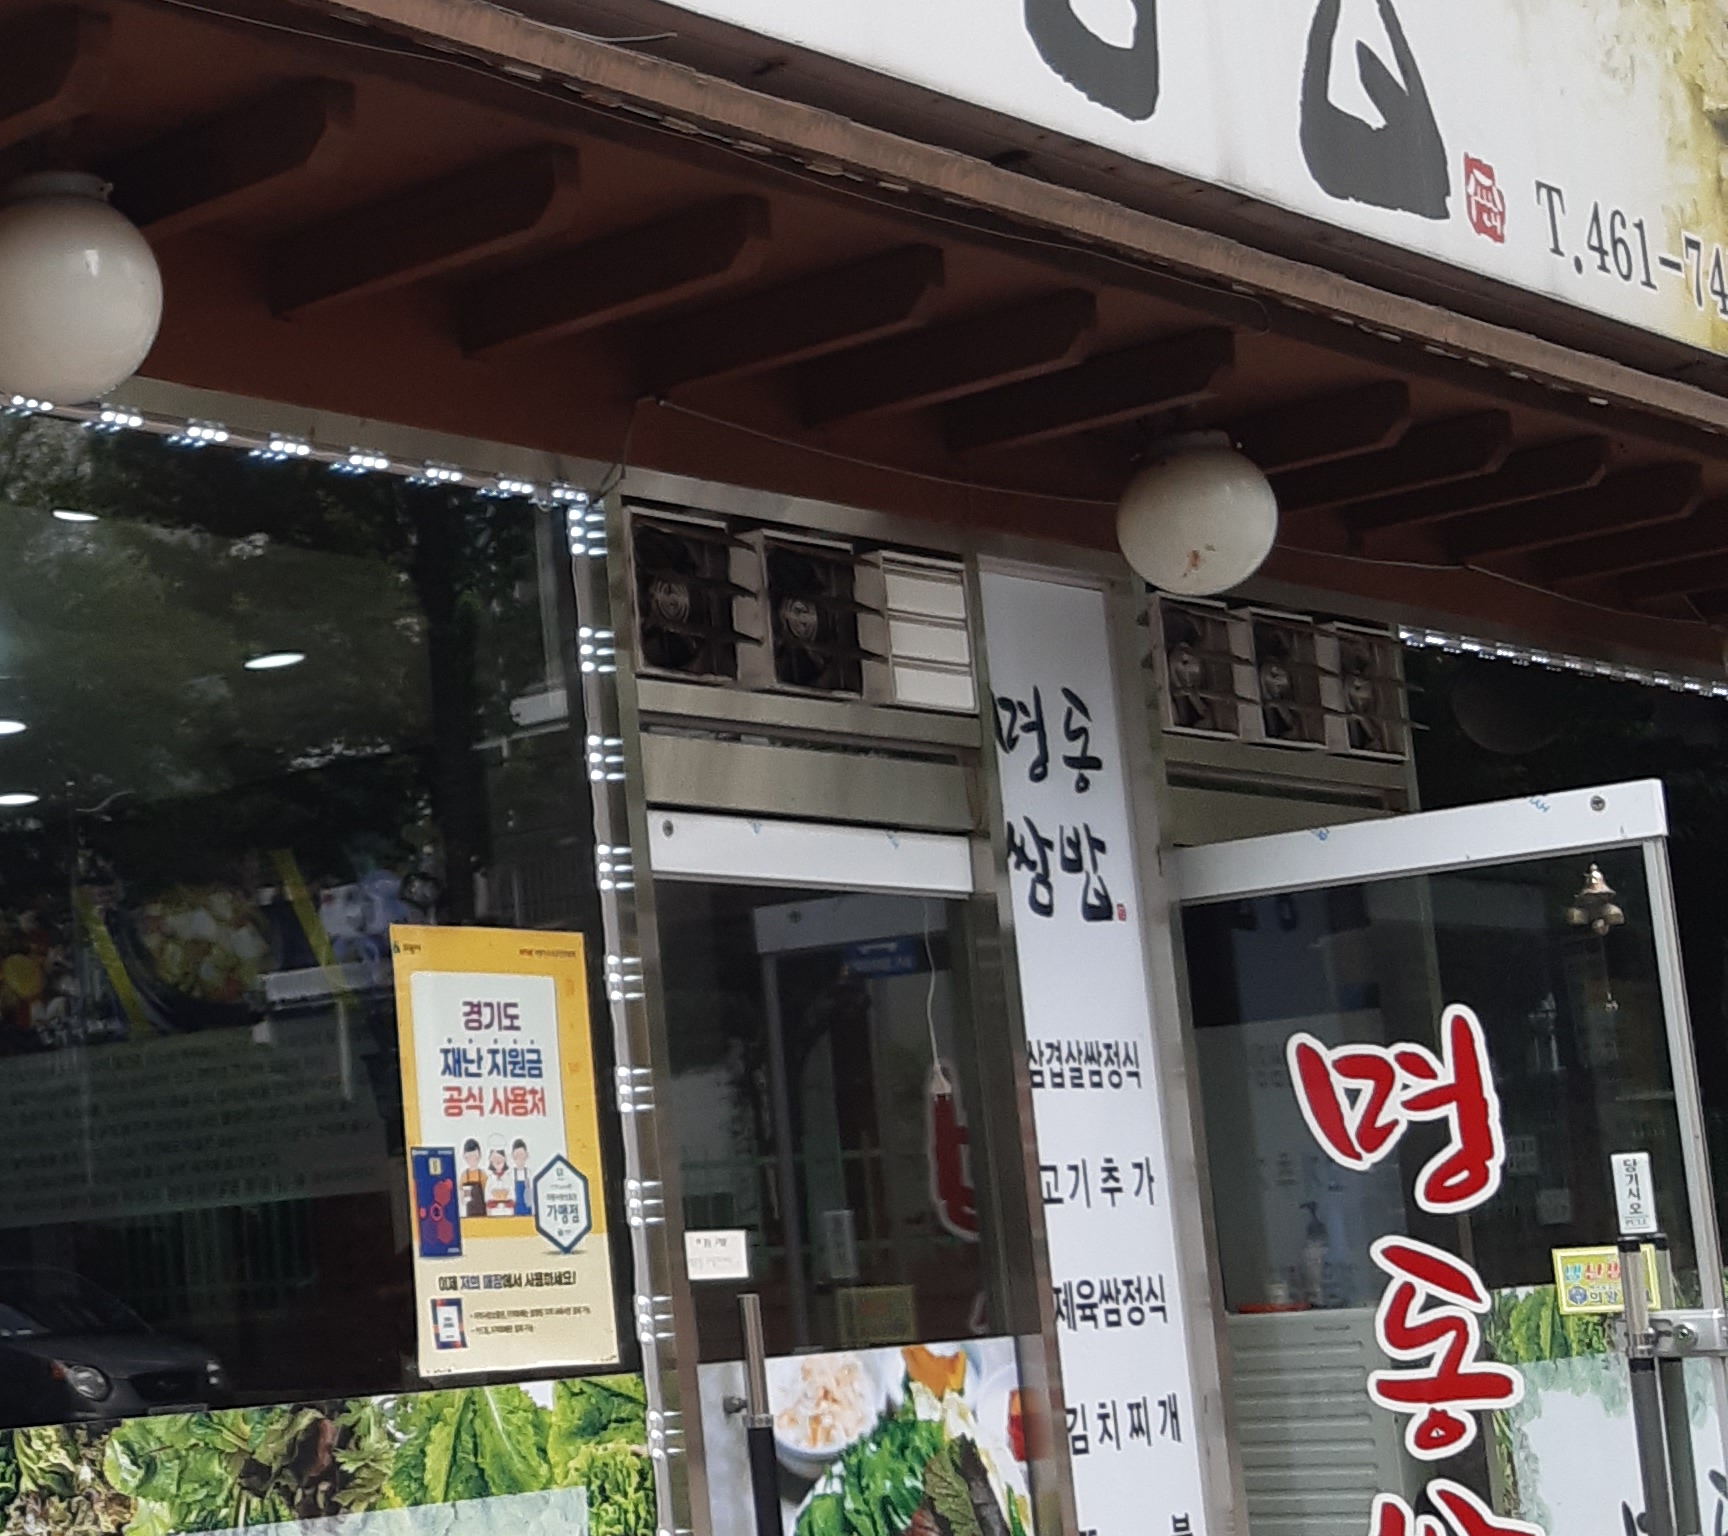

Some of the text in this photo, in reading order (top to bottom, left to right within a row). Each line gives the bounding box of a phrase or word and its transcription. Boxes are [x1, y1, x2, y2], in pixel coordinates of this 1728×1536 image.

[462, 1000, 522, 1032] 경기도
[439, 1046, 544, 1079] 재난 지원금
[442, 1085, 547, 1117] 공식 사용처
[1622, 1158, 1643, 1215] 당기시오
[1053, 1274, 1169, 1332] 제육쌈정식
[1067, 1393, 1183, 1456] 김치찌개
